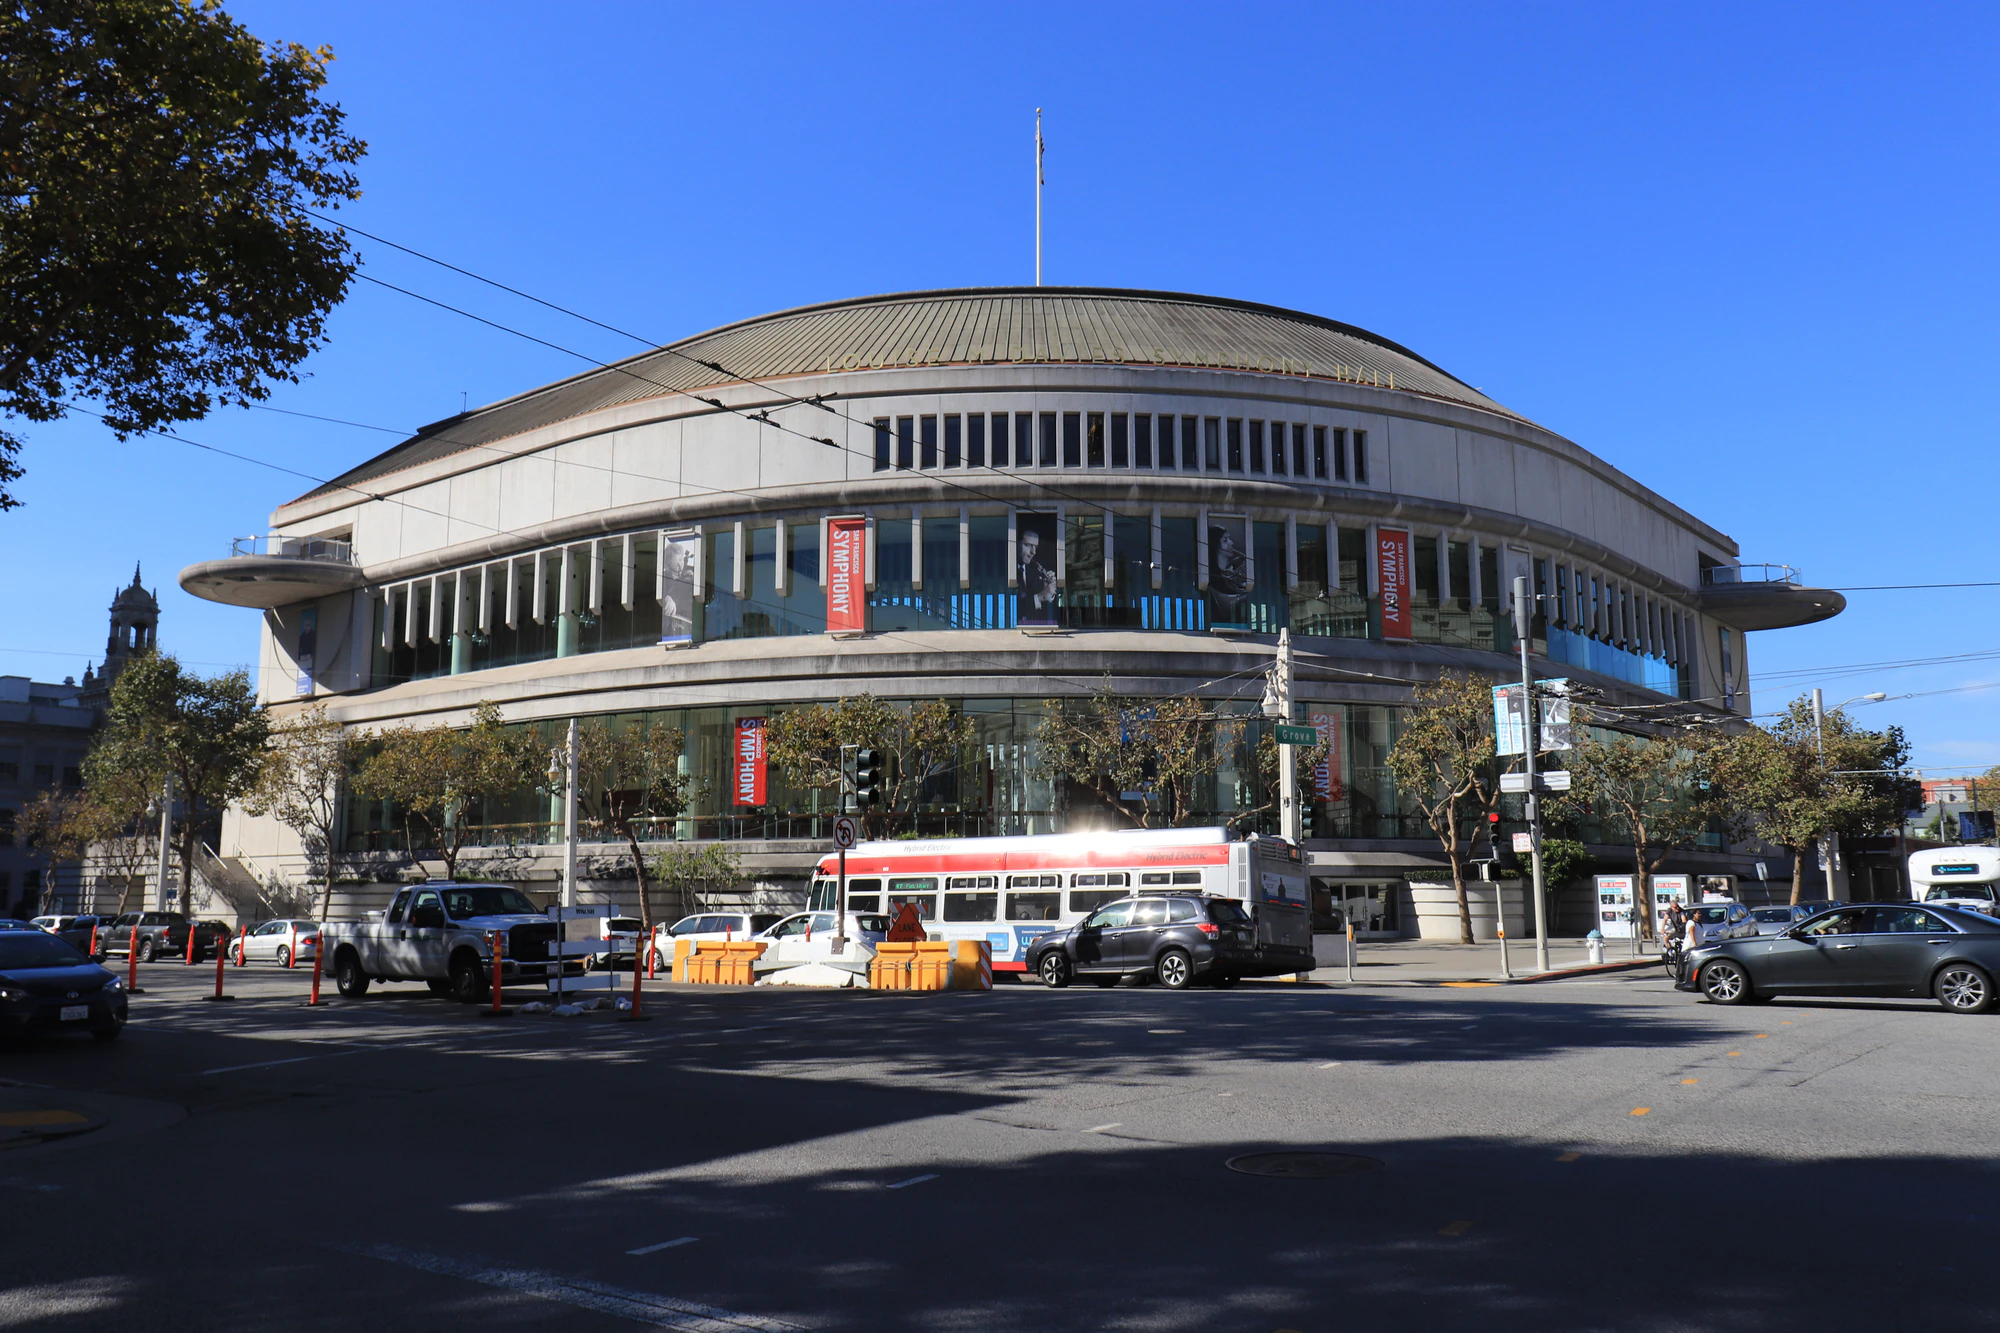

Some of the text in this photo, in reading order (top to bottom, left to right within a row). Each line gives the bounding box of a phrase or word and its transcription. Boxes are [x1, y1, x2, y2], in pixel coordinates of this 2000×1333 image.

[832, 530, 850, 614] SYMPHONY
[1381, 540, 1399, 622] SYMPHONY
[1282, 730, 1310, 741] Grove
[1499, 700, 1508, 739] FRANCISCO
[1512, 715, 1522, 752] SYMPHONY
[740, 719, 756, 803] SYMPHONY
[1501, 741, 1509, 753] SAN
[1146, 851, 1207, 862] Hybrid Electric
[899, 923, 916, 932] LANE
